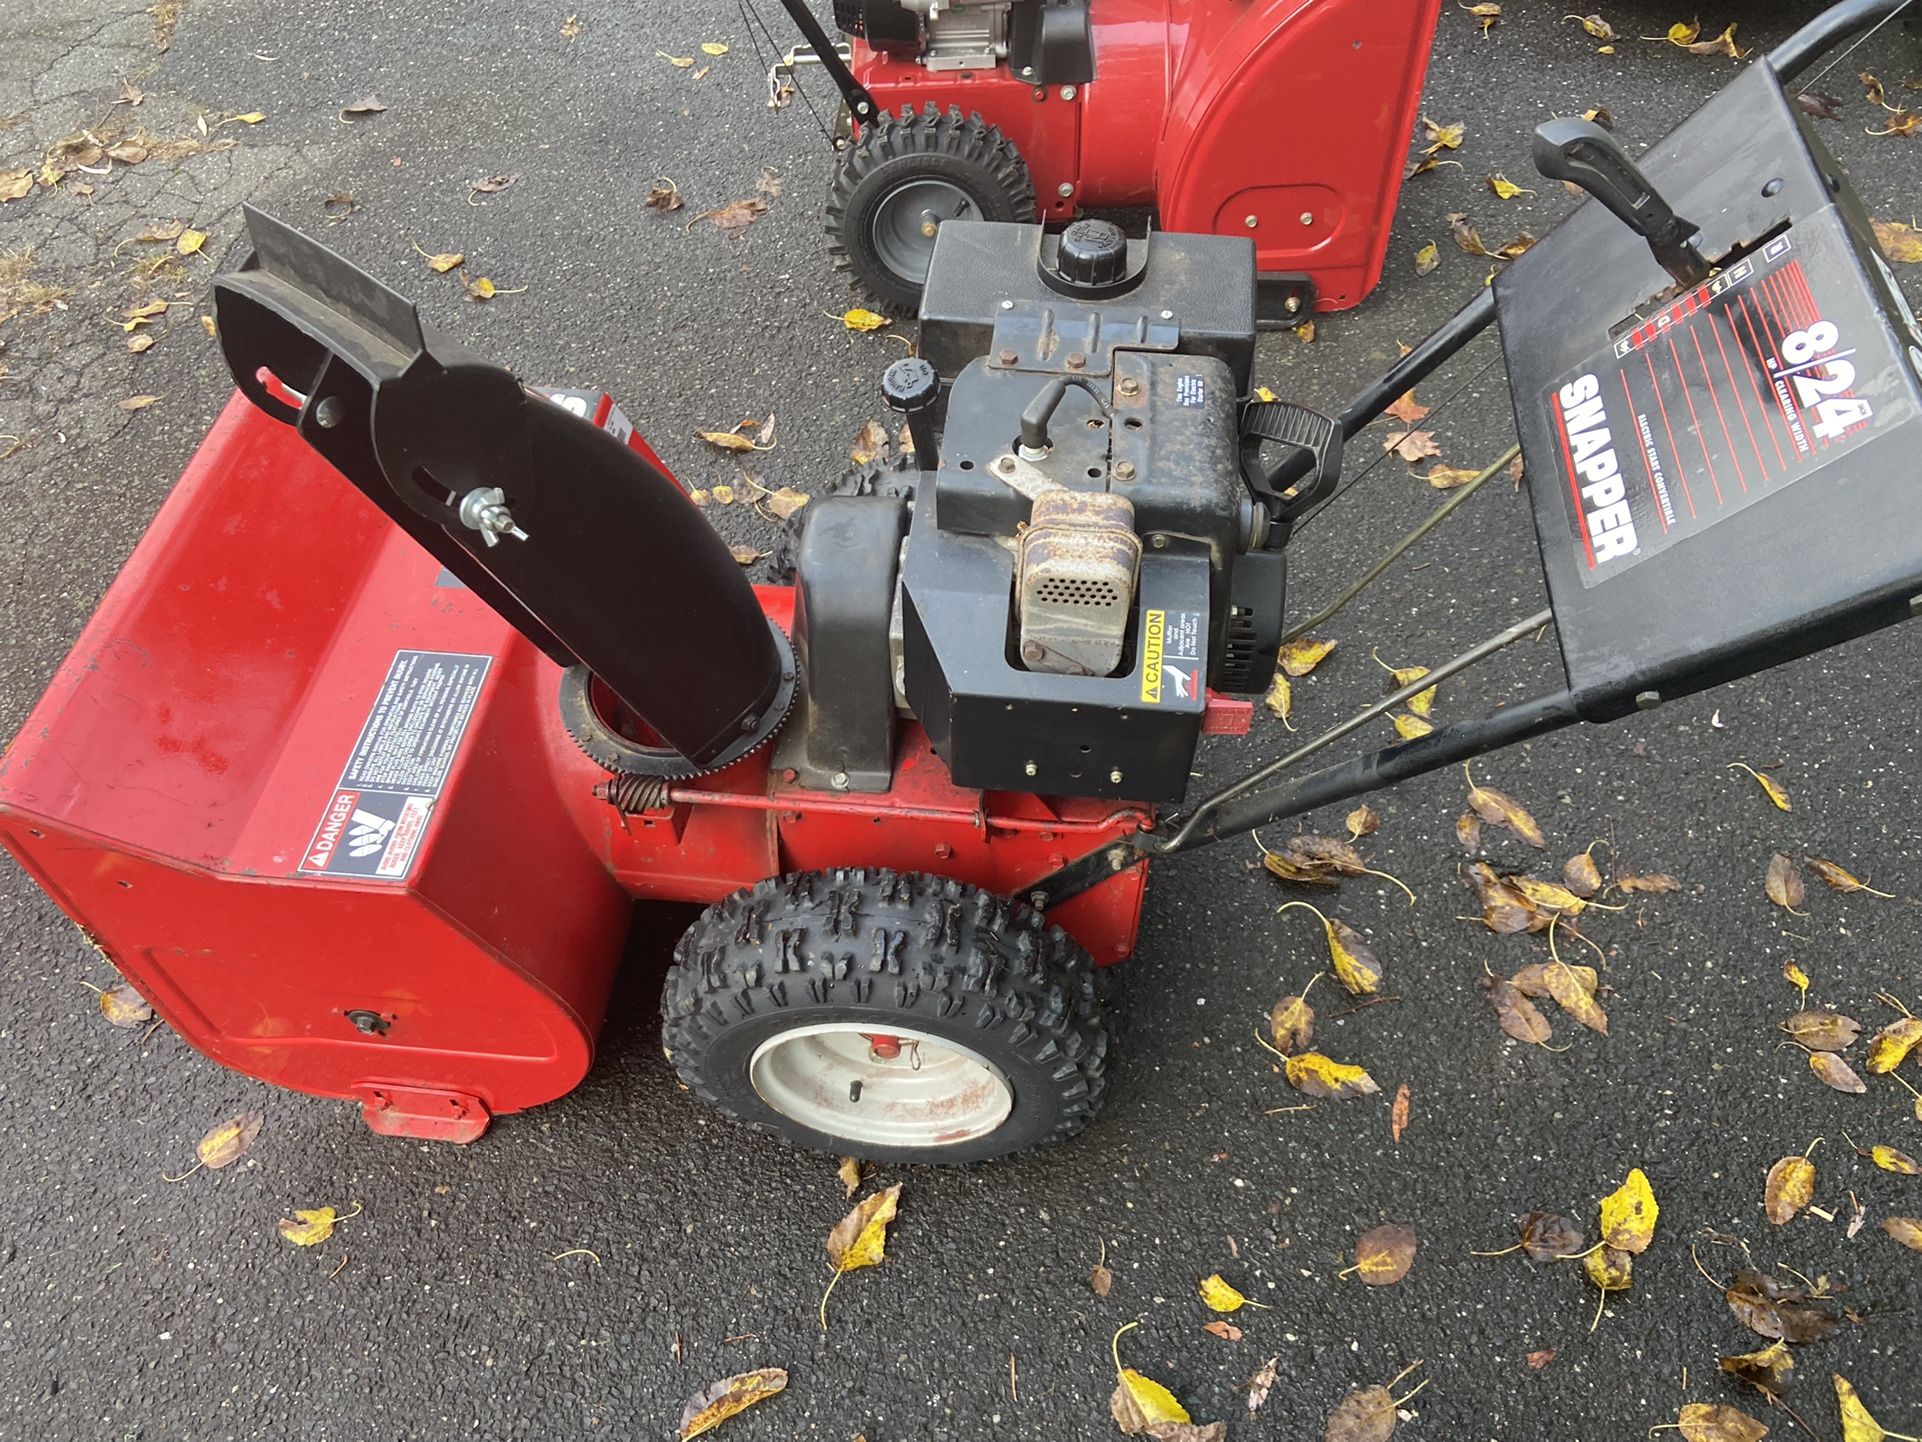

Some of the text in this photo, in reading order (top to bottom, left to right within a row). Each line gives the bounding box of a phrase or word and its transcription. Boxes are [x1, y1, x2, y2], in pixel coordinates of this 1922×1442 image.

[1765, 357, 1777, 370] HP
[1775, 379, 1809, 453] CLEARING WIDTH
[1560, 374, 1638, 563] SNAPPER
[1638, 413, 1676, 525] ELECTRIC START CONVERTIBLE
[1146, 613, 1162, 683] CAUTION
[377, 705, 387, 713] TO
[381, 680, 399, 704] PREVENT
[358, 714, 383, 756] INSTRUCTIONS
[347, 757, 364, 779] SAFETY
[318, 794, 355, 851] DANGER
